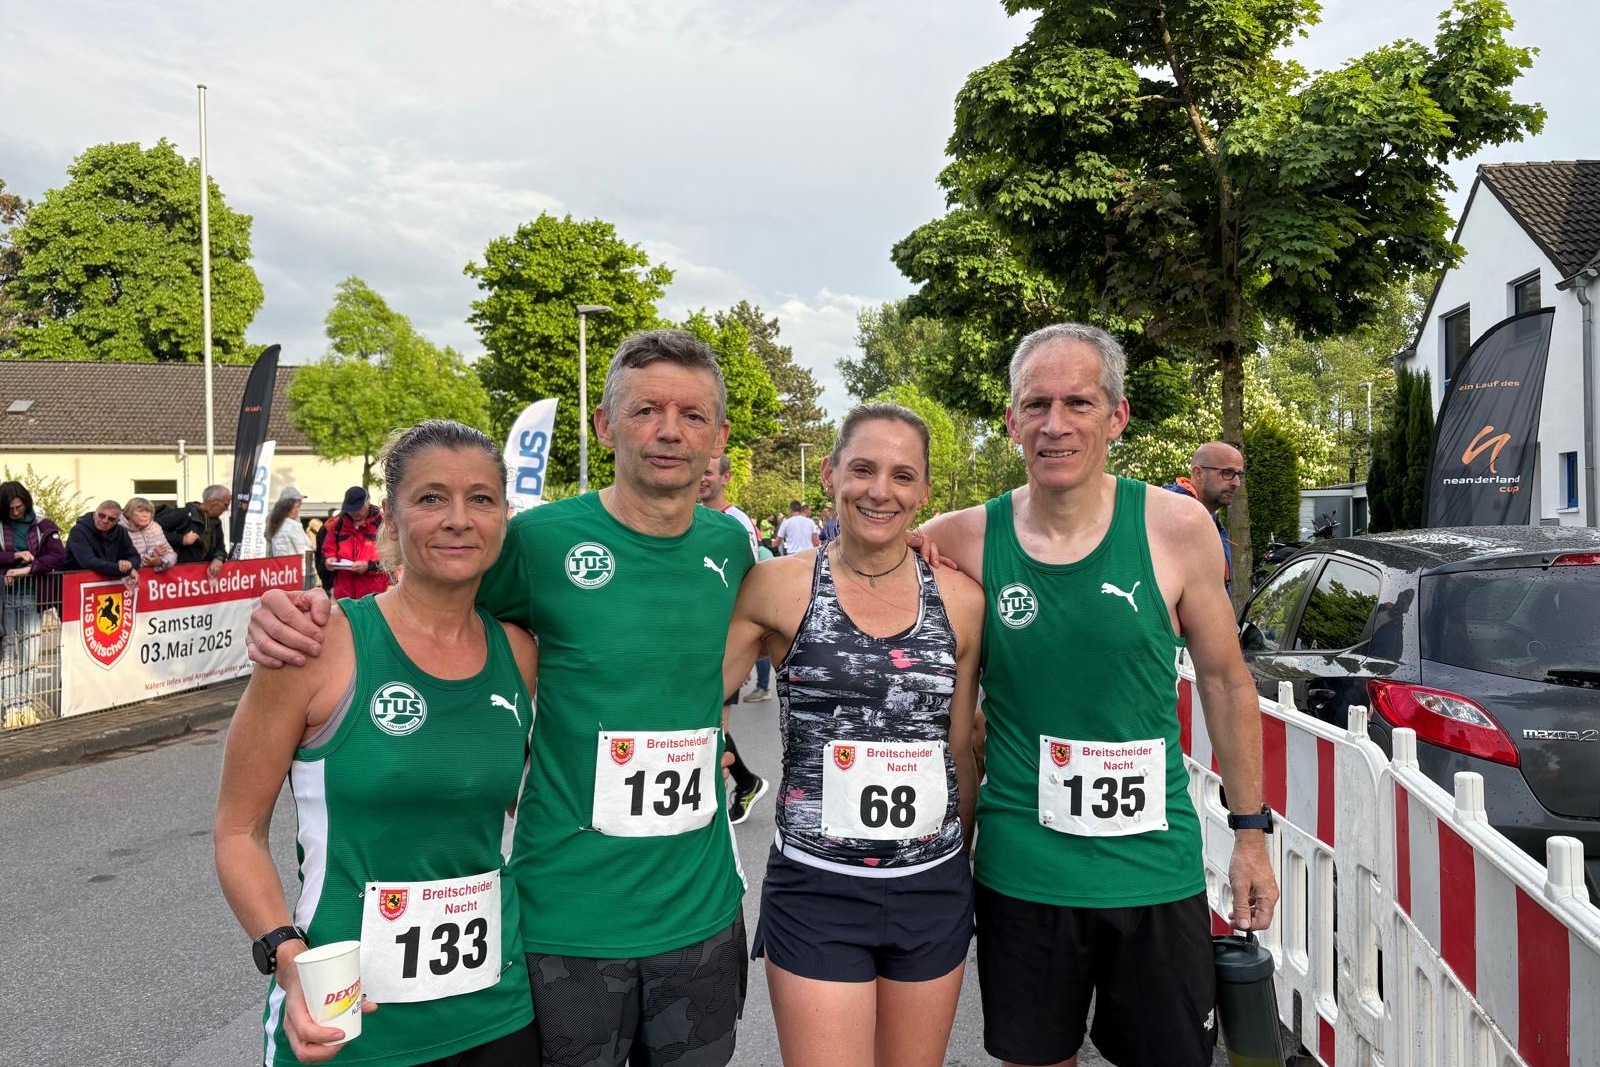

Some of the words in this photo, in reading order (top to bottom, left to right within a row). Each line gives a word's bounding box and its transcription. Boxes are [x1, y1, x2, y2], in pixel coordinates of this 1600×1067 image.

[1459, 383, 1474, 392] ein
[1475, 380, 1500, 389] Lauf
[1500, 379, 1520, 388] des
[515, 430, 548, 496] DUS
[1443, 475, 1521, 485] neanderland
[1499, 485, 1520, 494] cup
[571, 557, 610, 570] TUS
[148, 571, 257, 601] Breitscheider
[260, 566, 298, 588] Nacht
[85, 593, 95, 624] TuS
[1002, 598, 1033, 611] TUS
[148, 612, 214, 636] Samstag
[85, 626, 130, 658] Breitscheid
[140, 637, 194, 665] 03.Mai
[198, 629, 233, 654] 2025
[378, 699, 421, 715] TUS
[646, 736, 709, 749] Breitscheider
[667, 752, 695, 763] Nacht
[866, 747, 933, 759] Breitscheider
[1082, 746, 1153, 758] Breitscheider
[887, 762, 918, 772] Nacht
[1103, 761, 1134, 771] Nacht
[624, 767, 702, 816] 134
[1063, 775, 1146, 819] 135
[860, 784, 917, 829] 68
[422, 880, 494, 901] Breitscheider
[444, 900, 478, 915] Nacht
[395, 917, 489, 979] 133
